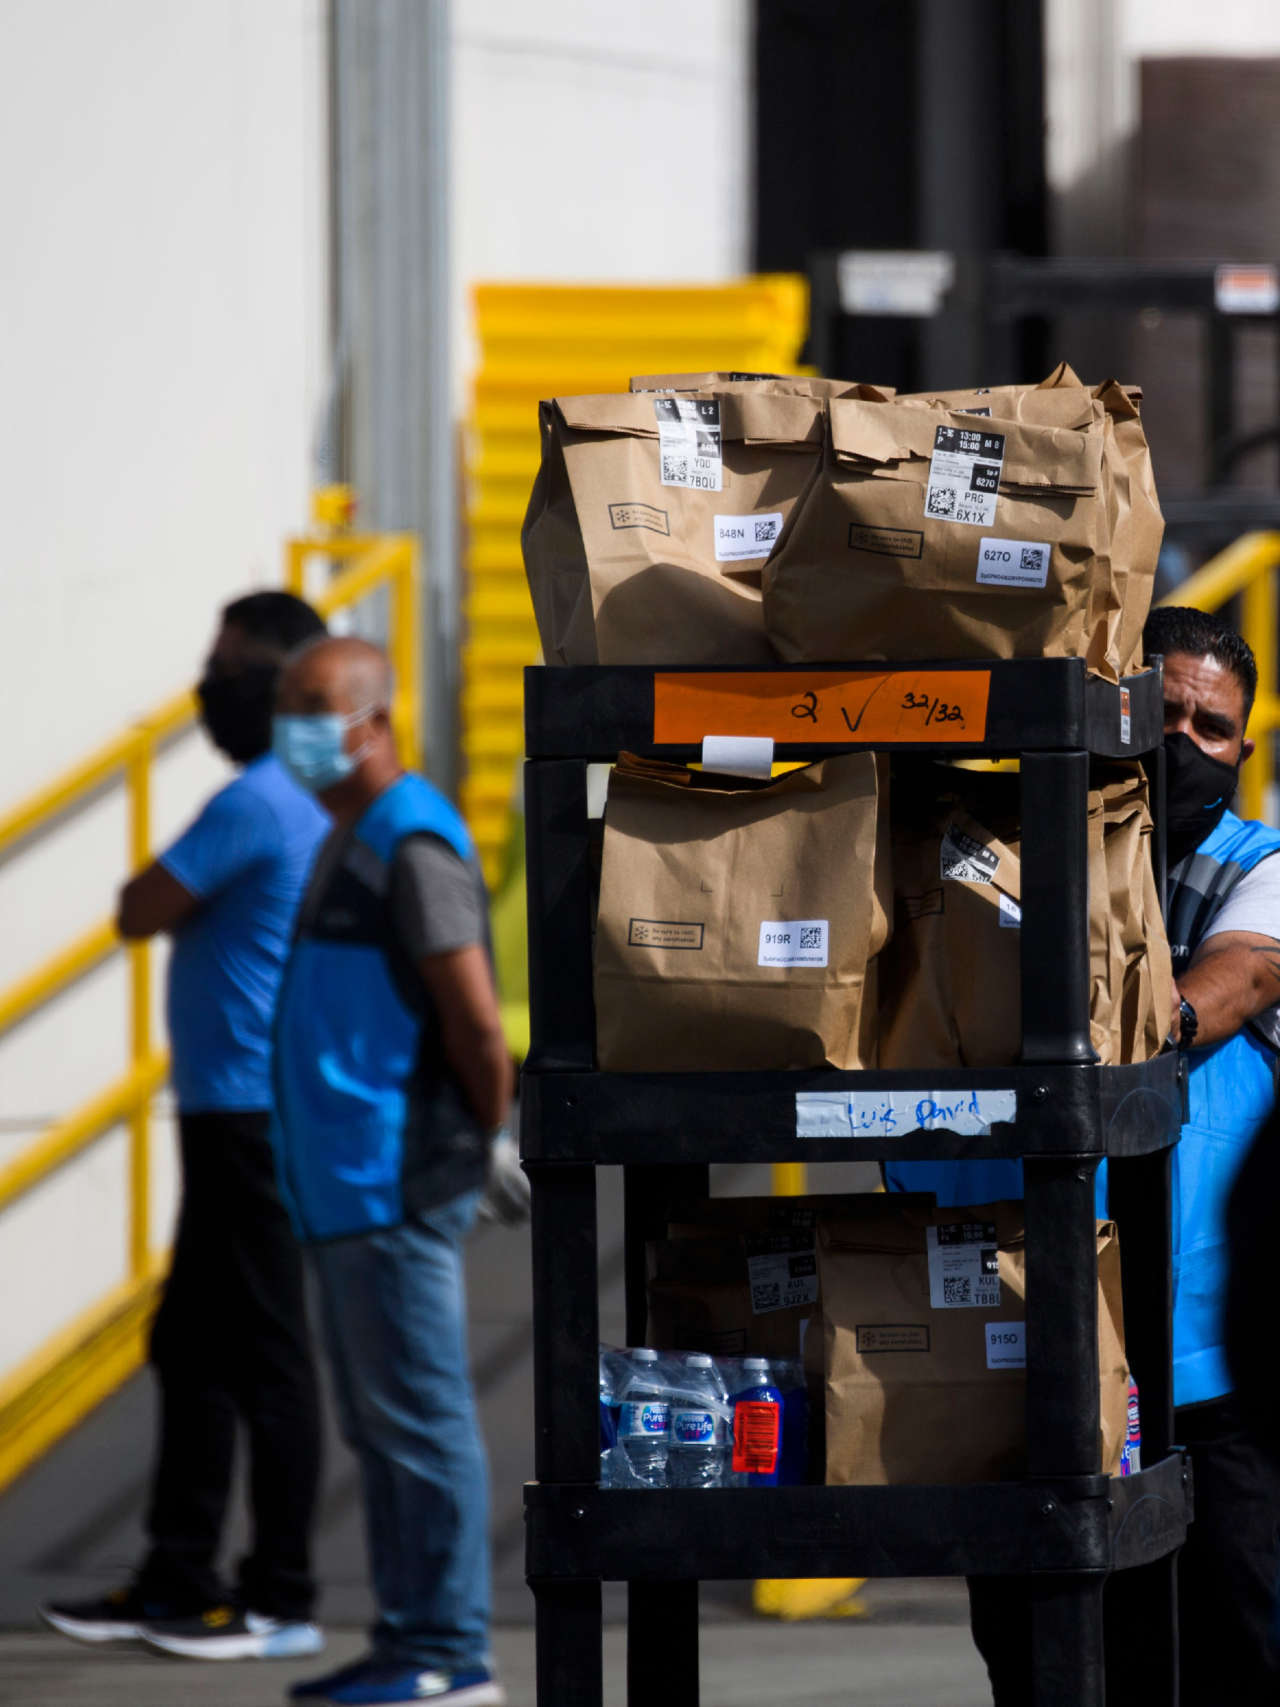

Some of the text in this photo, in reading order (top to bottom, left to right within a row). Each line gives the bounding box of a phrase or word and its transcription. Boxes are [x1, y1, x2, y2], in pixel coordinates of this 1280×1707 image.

[964, 492, 984, 504] PRG
[956, 509, 985, 524] 6X1X
[719, 528, 744, 539] 848N
[765, 934, 792, 945] 919R
